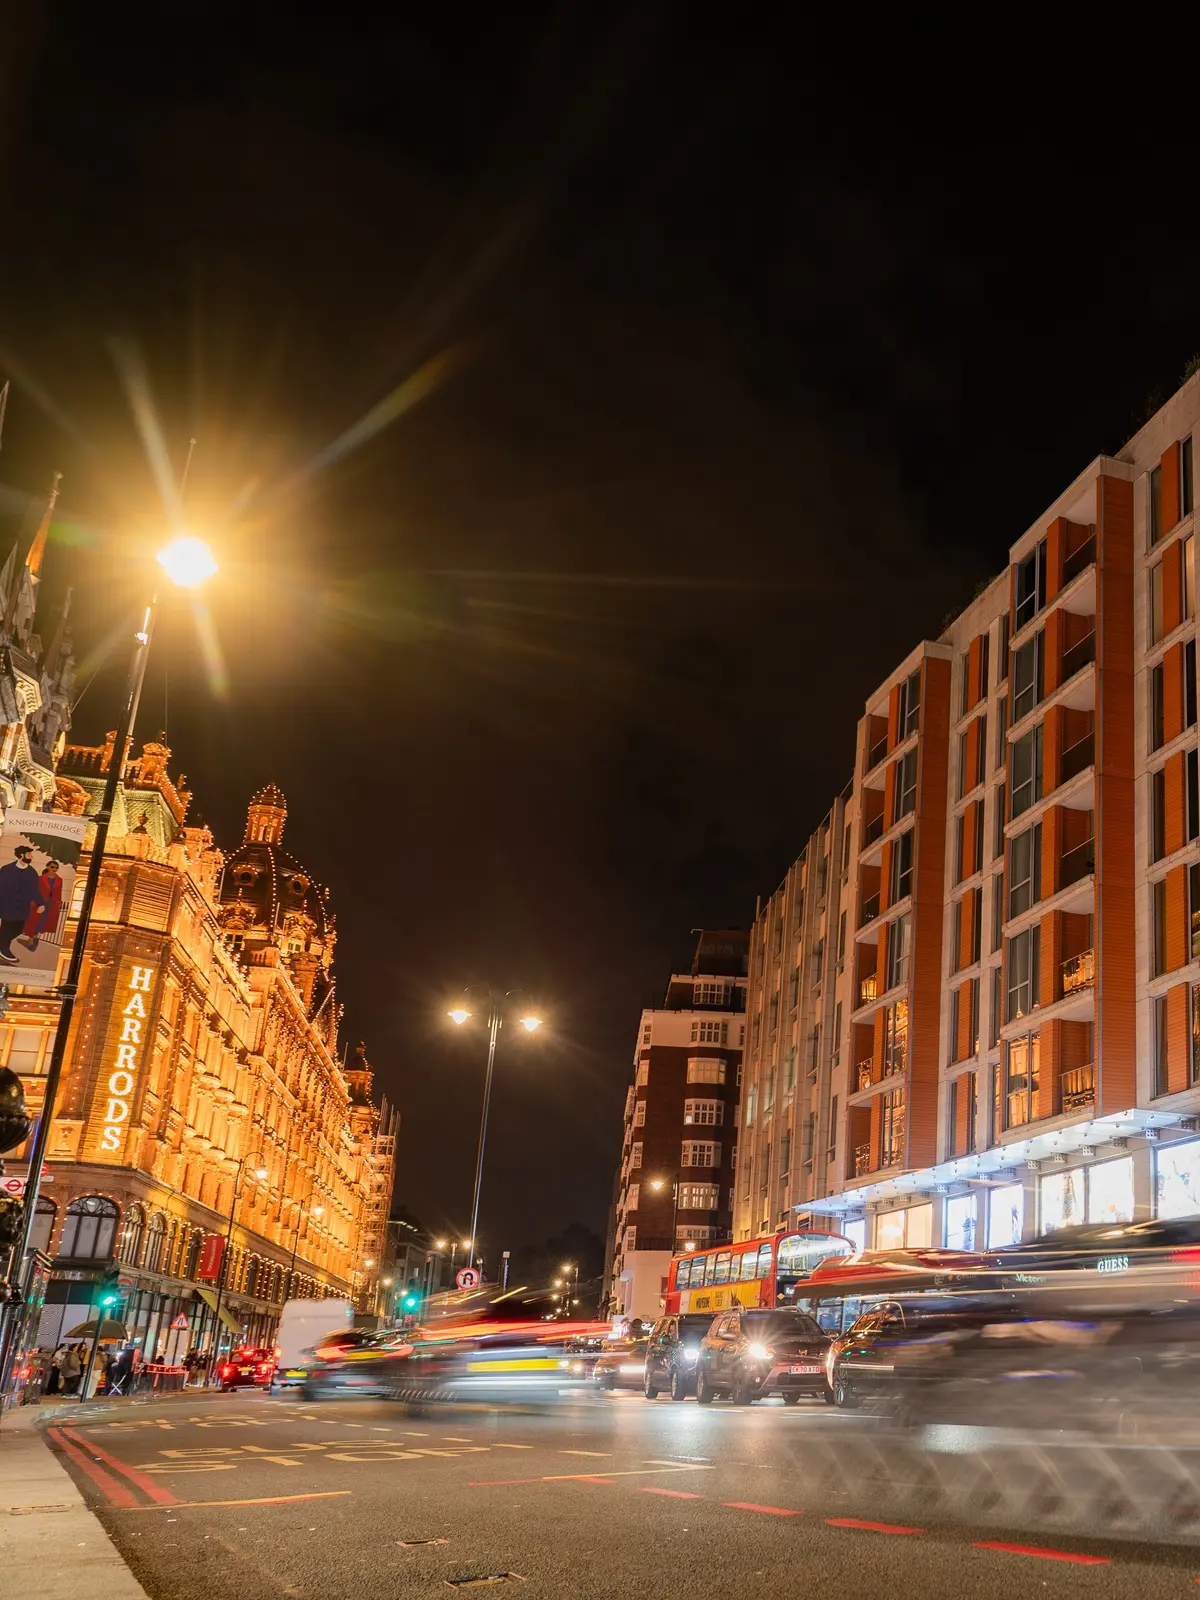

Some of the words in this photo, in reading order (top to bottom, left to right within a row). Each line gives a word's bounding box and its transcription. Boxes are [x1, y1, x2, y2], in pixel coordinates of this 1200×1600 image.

[101, 966, 154, 1151] HARRODS
[1097, 1256, 1129, 1273] GUESS
[135, 1446, 492, 1474] STOP
[159, 1439, 404, 1459] BUS
